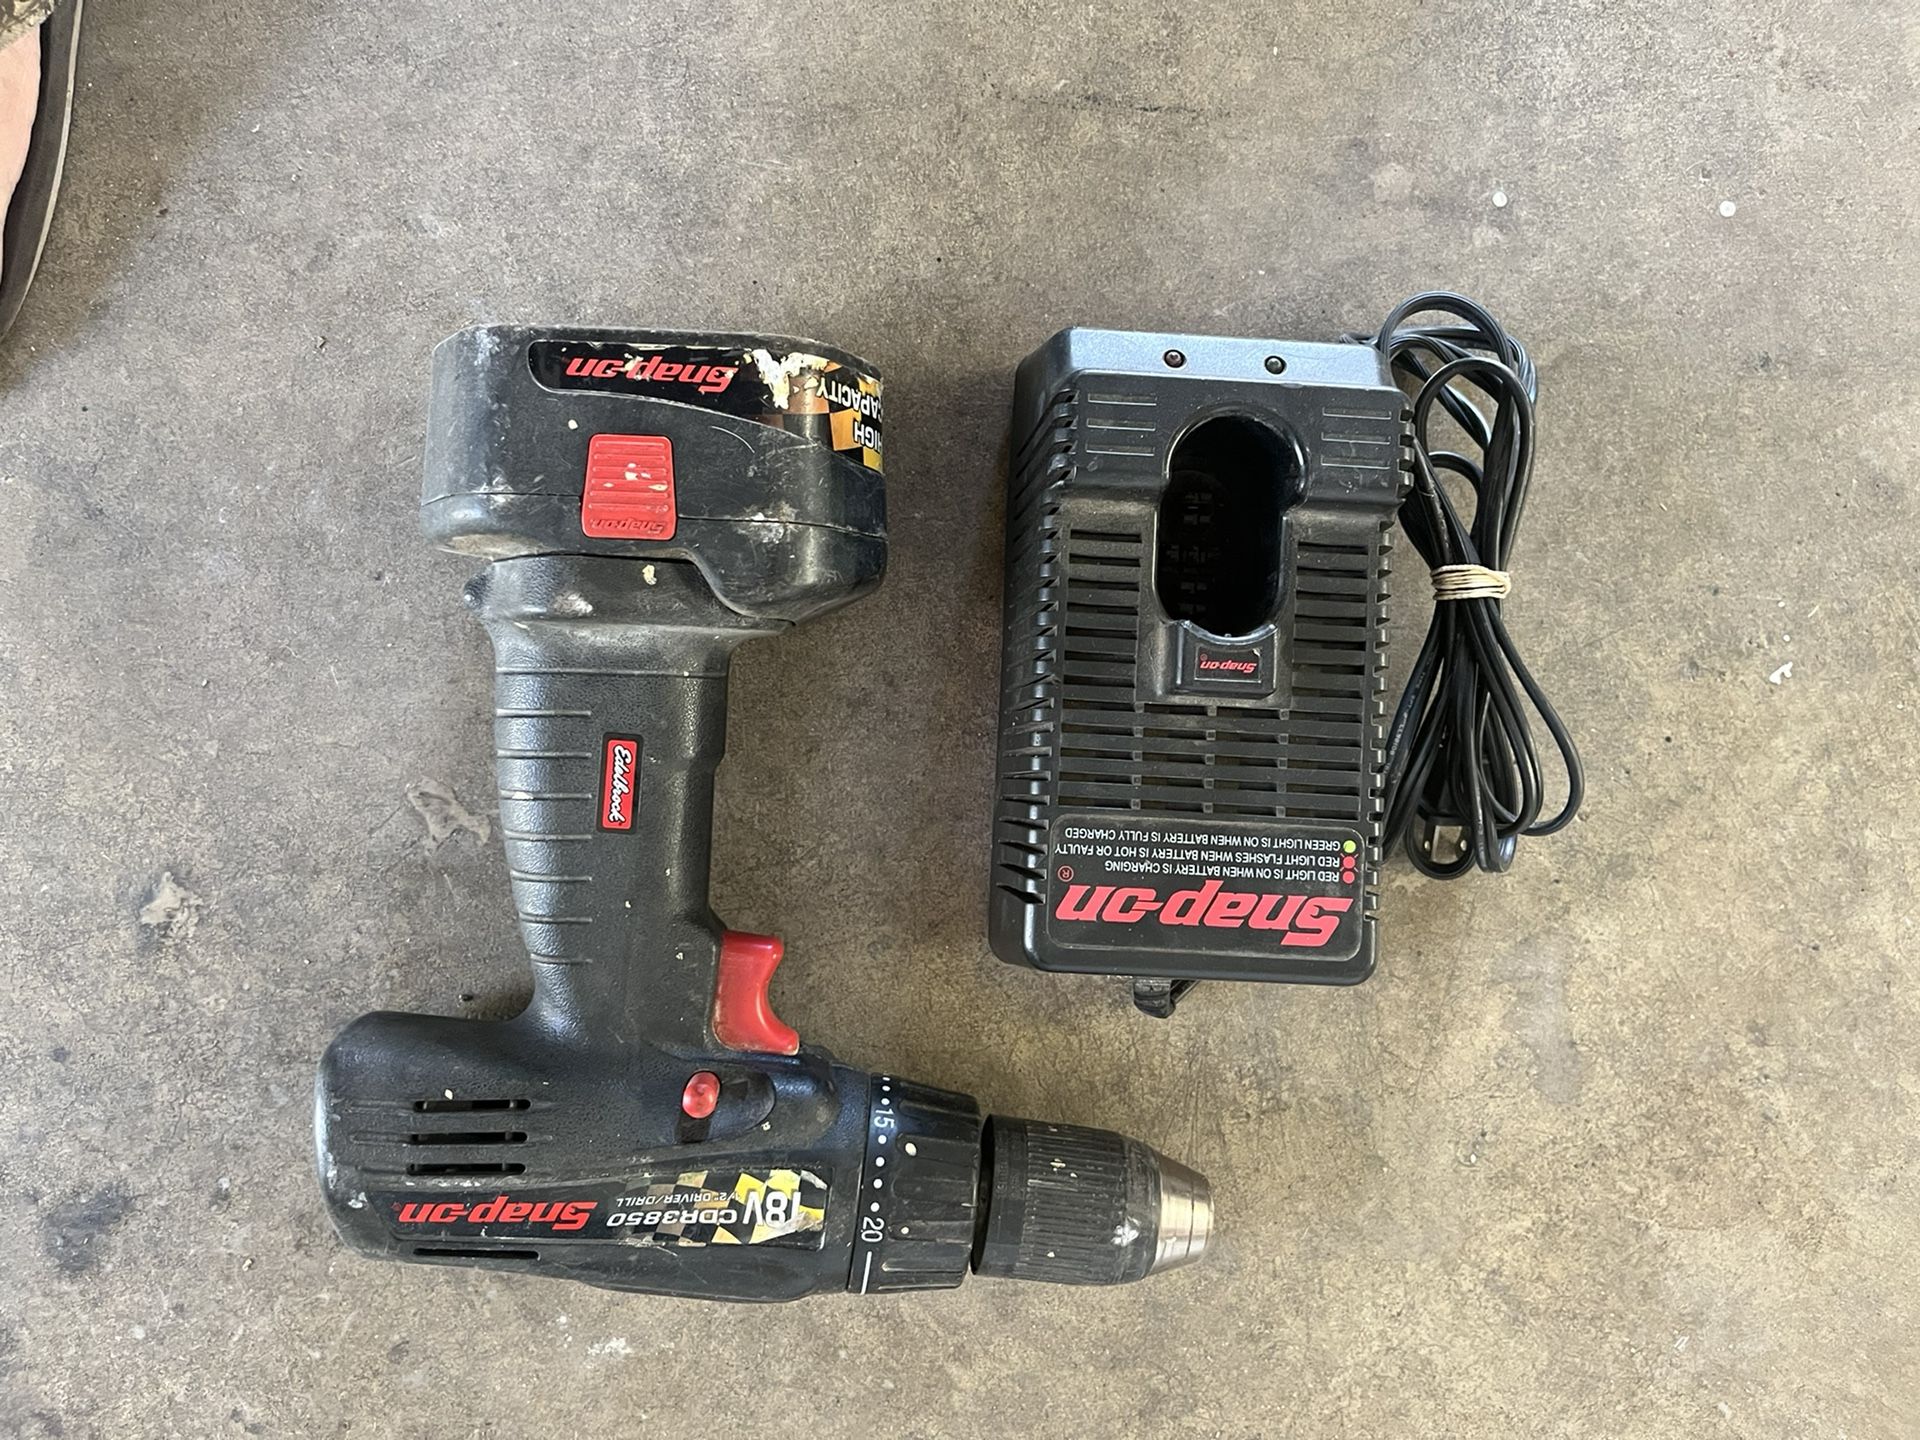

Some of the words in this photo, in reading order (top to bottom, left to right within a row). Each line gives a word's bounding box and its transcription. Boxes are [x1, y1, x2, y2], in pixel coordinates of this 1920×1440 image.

[566, 356, 739, 393] Snap-on
[1200, 660, 1257, 673] Snap-on
[609, 745, 632, 822] Edelbrock
[1065, 827, 1116, 840] CHARGED
[1119, 830, 1149, 842] FULLY
[1151, 831, 1161, 842] IS
[1163, 832, 1208, 845] BATTERY
[1211, 834, 1242, 847] WHEN
[1244, 836, 1259, 848] ON
[1261, 836, 1271, 848] IS
[1273, 838, 1303, 849] LIGHT
[1305, 840, 1341, 851] GREEN
[1054, 843, 1095, 856] FAULTY
[1096, 845, 1112, 857] OR
[1114, 846, 1137, 858] HOT
[1139, 847, 1149, 859] IS
[1152, 848, 1198, 861] BATTERY
[1200, 850, 1234, 862] WHEN
[1235, 852, 1281, 865] FLASHES
[1284, 854, 1316, 866] LIGHT
[1318, 856, 1340, 867] RED
[1105, 860, 1161, 874] CHARGING
[1163, 862, 1172, 874] IS
[1175, 863, 1220, 876] BATTERY
[1222, 866, 1255, 878] WHEN
[1256, 867, 1272, 879] ON
[1274, 868, 1284, 880] IS
[1285, 869, 1316, 881] LIGHT
[1318, 870, 1340, 882] RED
[1055, 879, 1353, 947] Snap-on
[873, 1108, 895, 1129] 15
[616, 1191, 711, 1208] DRIVER/DRILL
[399, 1195, 598, 1231] Snap-on
[606, 1209, 737, 1227] CDR3850
[861, 1216, 885, 1243] 20
